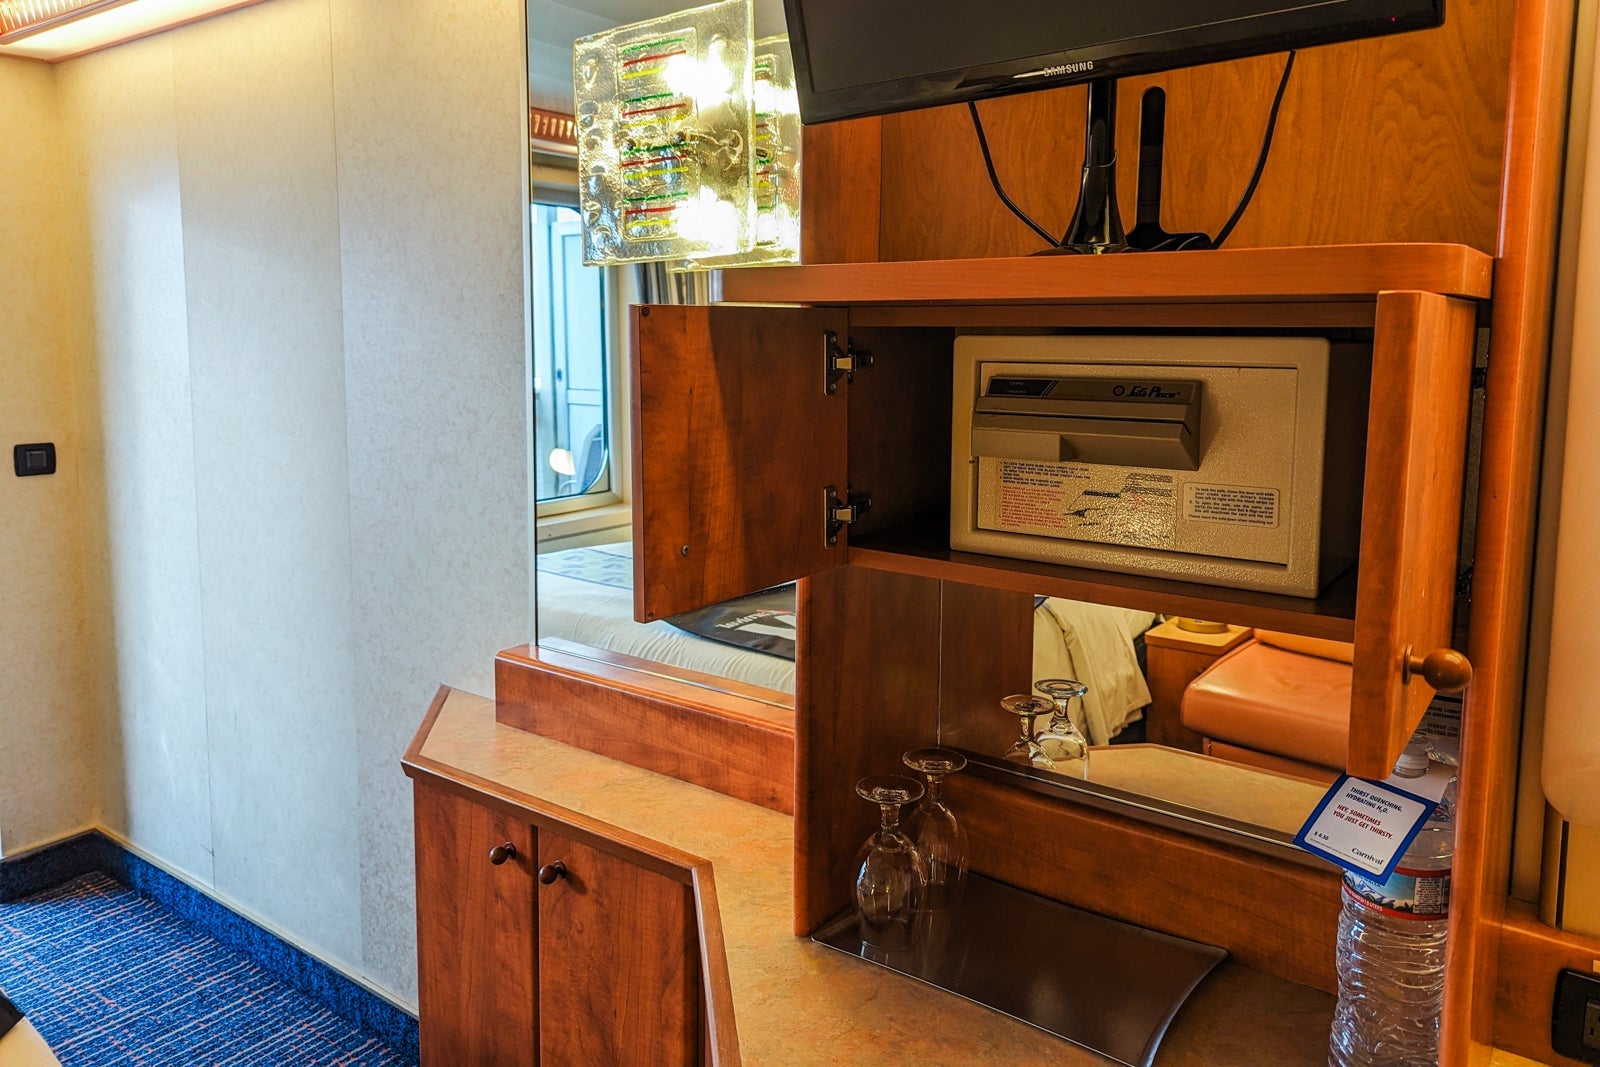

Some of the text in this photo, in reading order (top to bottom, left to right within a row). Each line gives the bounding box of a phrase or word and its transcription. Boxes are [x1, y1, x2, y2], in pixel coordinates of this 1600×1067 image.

[1044, 61, 1094, 77] SAMSUNG
[1346, 792, 1376, 809] HYDRATING
[1350, 786, 1370, 798] THIRST
[1332, 810, 1393, 840] YOU JUST GET THIRSTY.
[1349, 809, 1381, 826] SOMETIMES
[1318, 833, 1329, 841] 4.50
[1351, 847, 1384, 866] Carnival
